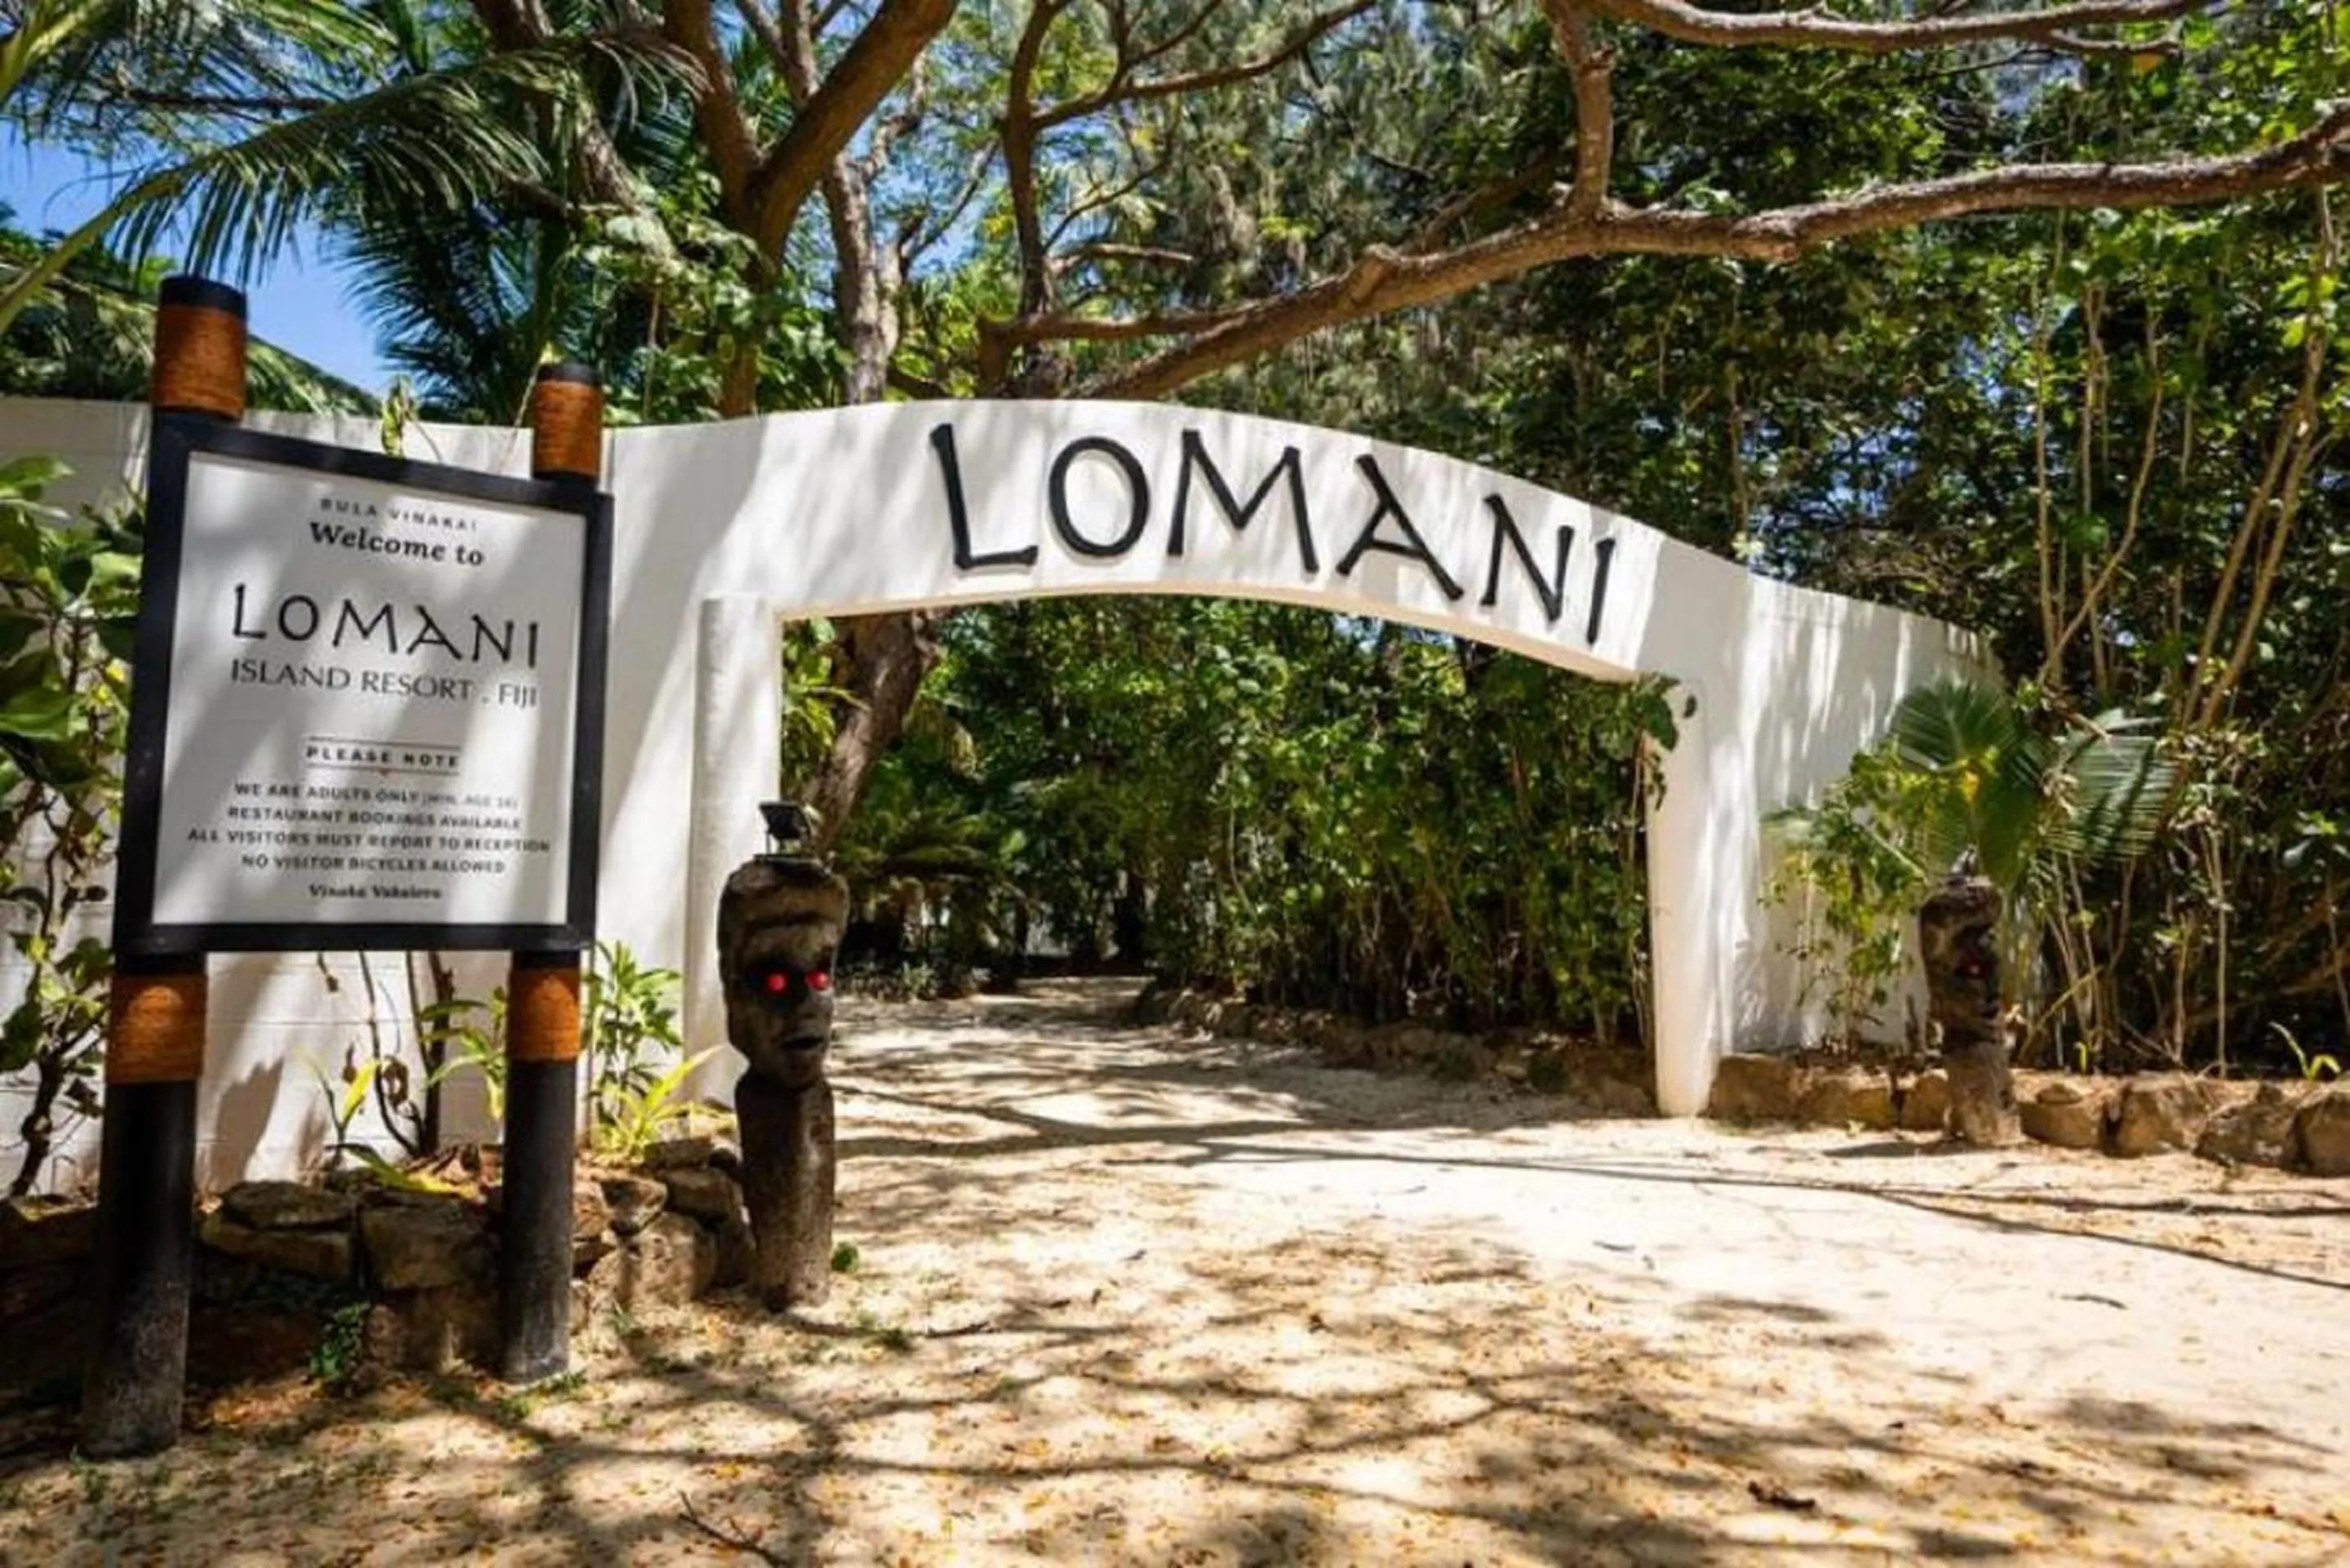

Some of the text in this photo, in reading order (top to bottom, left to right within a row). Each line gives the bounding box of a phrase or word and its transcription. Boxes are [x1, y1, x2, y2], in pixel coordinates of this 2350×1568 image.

[321, 498, 377, 516] BULA
[310, 522, 484, 566] Welcome to
[929, 423, 1616, 644] LOMANI
[233, 583, 539, 669] LOMANI
[231, 658, 351, 689] ISLAND
[361, 669, 472, 700] RESORT
[499, 684, 537, 707] FIJI
[307, 746, 458, 768] PLEASE NOTE
[234, 783, 259, 796] WE
[268, 785, 299, 797] ARE
[307, 786, 371, 800] ADULTS
[376, 789, 419, 803] ONLY
[228, 807, 520, 828] RESTAURANT BOOKINGS AVAILABLE
[188, 828, 550, 853] ALL VISITORS MUST REPORT TO RECEPTION
[242, 853, 505, 874] NO VISITOR BICYCLES ALLOWED
